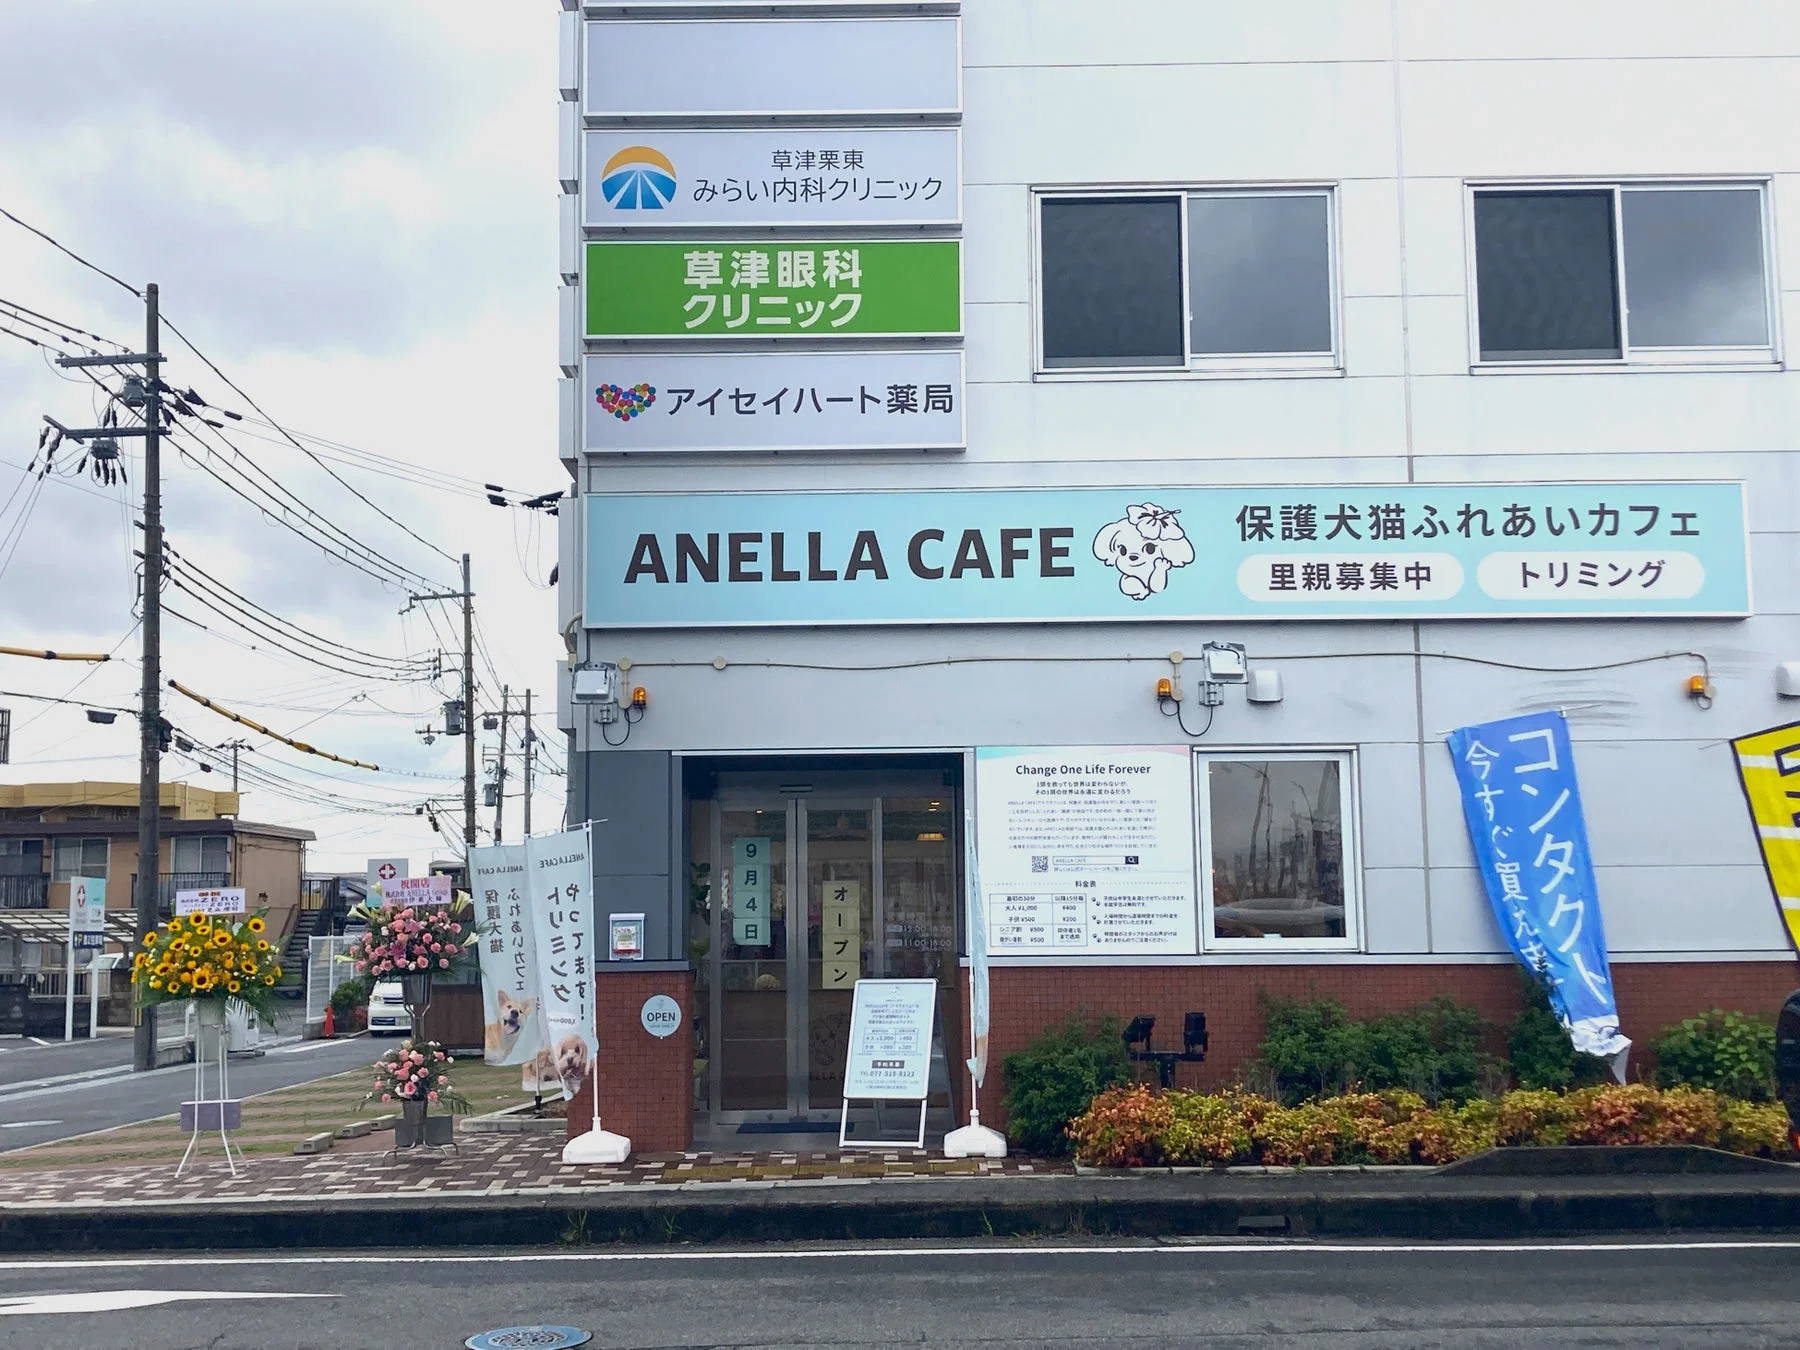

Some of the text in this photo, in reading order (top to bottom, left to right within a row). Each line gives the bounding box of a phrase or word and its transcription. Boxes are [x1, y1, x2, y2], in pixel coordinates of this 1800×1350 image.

[771, 149, 865, 171] 草津栗東
[693, 177, 943, 203] みらい内科クリニック
[683, 249, 862, 289] 草津眼科
[683, 293, 862, 329] クリニック
[666, 384, 954, 415] アイセイハート薬局
[1235, 503, 1701, 542] 保護犬猫ふれあいカフェ
[623, 527, 1075, 584] ANELLA CAFE
[1269, 561, 1433, 592] 里親募集中
[1519, 559, 1666, 590] トリミング
[1015, 764, 1151, 777] Change One Life Forever
[1508, 728, 1607, 1005] コンタクト
[744, 843, 758, 940] 9月4日
[833, 886, 848, 983] オープン
[647, 1012, 676, 1022] OPEN
